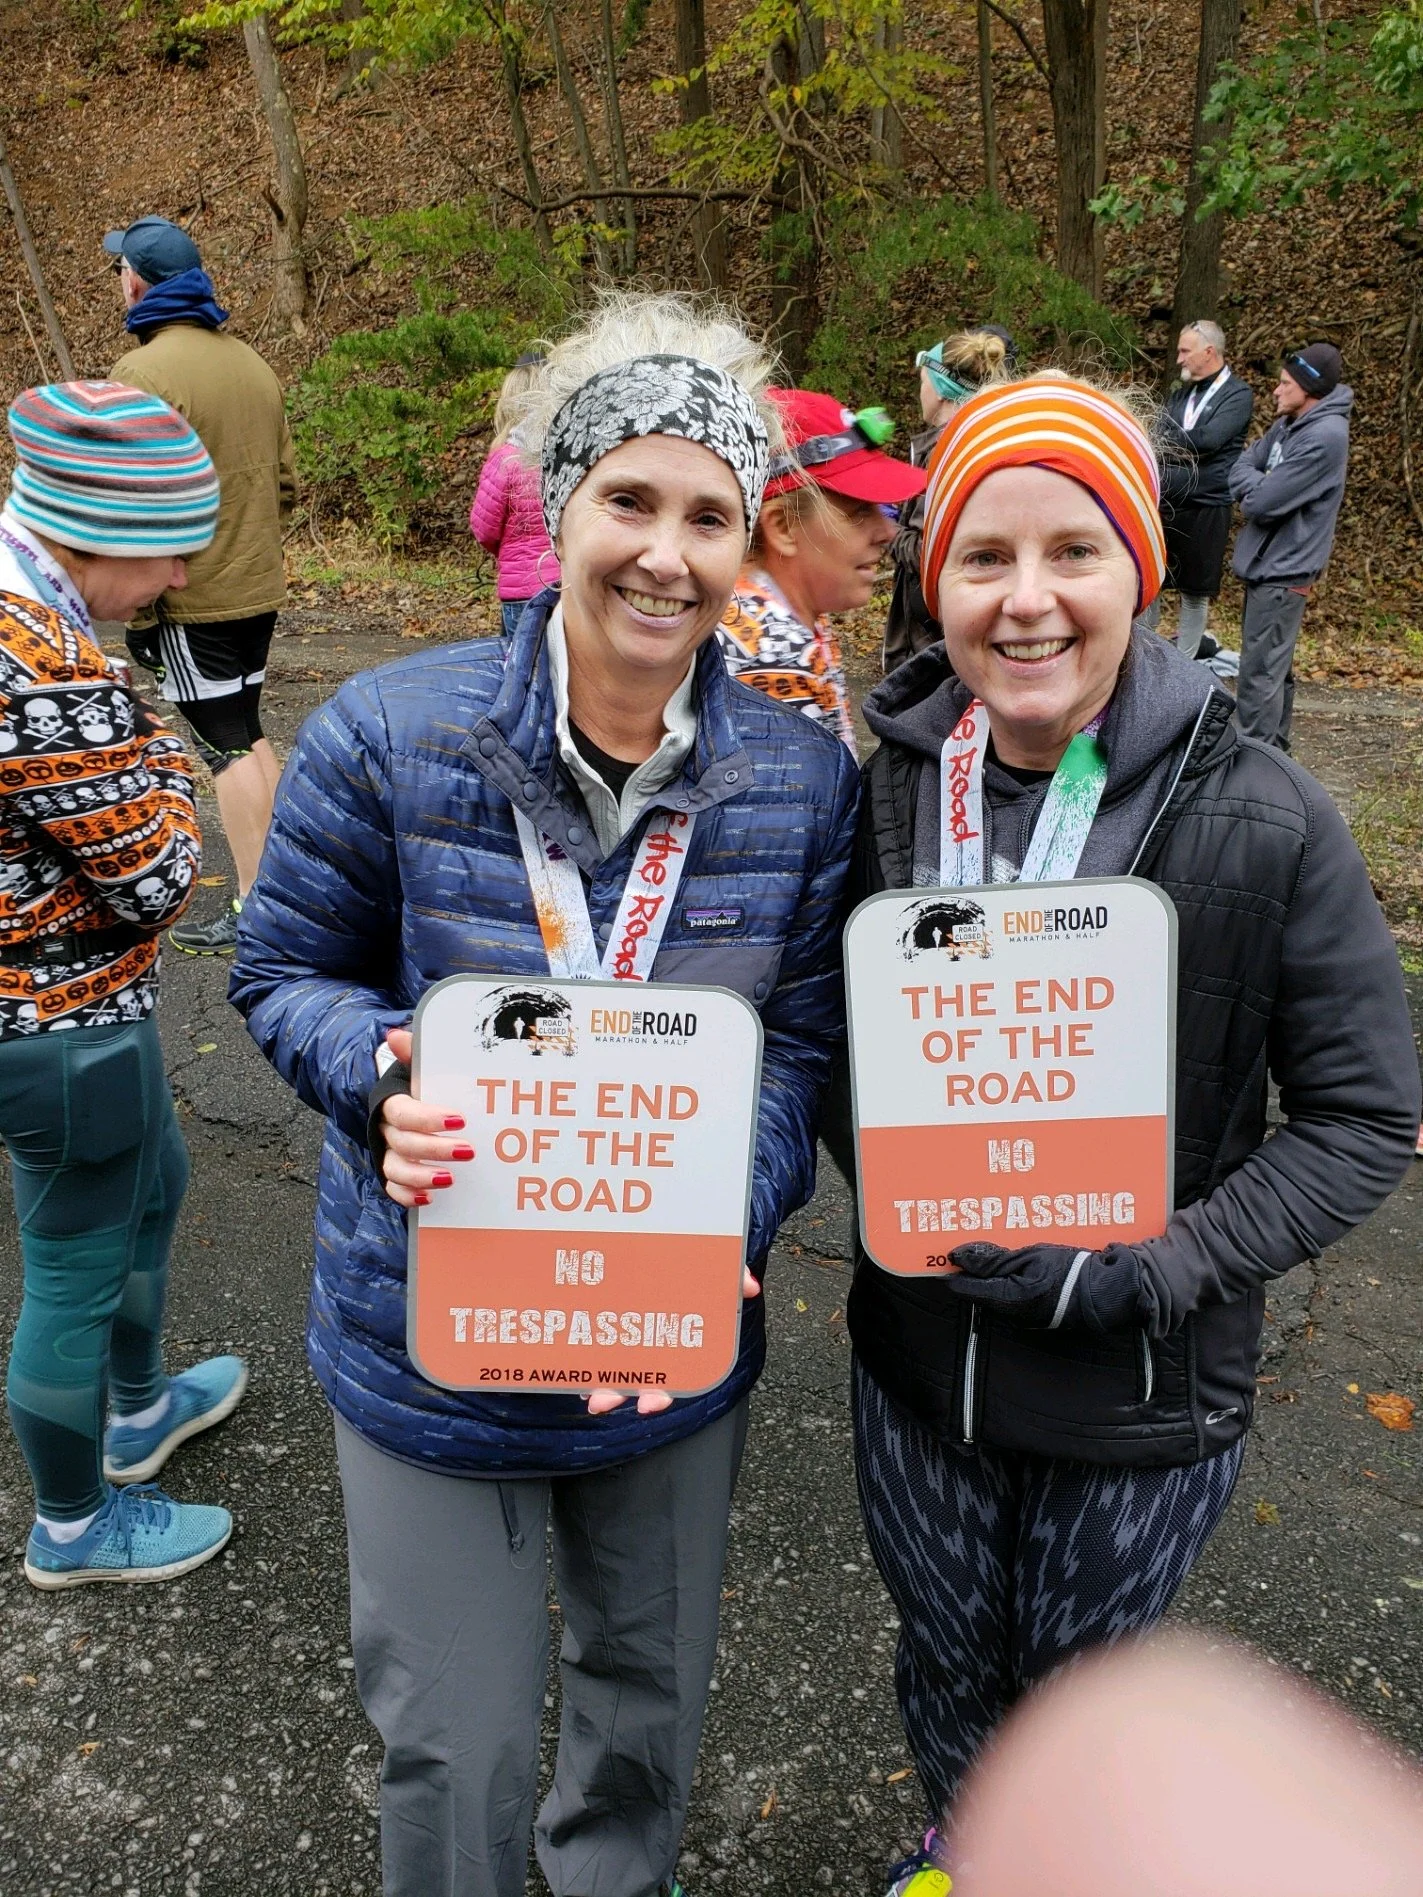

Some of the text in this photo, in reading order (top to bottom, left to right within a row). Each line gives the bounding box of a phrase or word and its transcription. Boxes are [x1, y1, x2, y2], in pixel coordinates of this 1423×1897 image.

[948, 747, 979, 843] Road
[641, 831, 684, 886] the
[613, 895, 665, 981] Road
[690, 918, 738, 928] patagonia
[955, 933, 982, 941] CLOSED
[958, 925, 978, 933] ROAD
[1004, 906, 1108, 935] END OF THE ROAD
[1009, 935, 1060, 943] MARATHON
[901, 976, 1115, 1020] THE END
[538, 1027, 567, 1036] CLOSED
[542, 1018, 563, 1027] ROAD
[590, 1009, 697, 1037] END OF THE ROAD
[595, 1036, 647, 1045] MARATHON
[921, 1023, 1095, 1064] OF THE
[477, 1078, 700, 1120] THE END
[946, 1069, 1077, 1107] ROAD
[494, 1127, 676, 1168] OF THE
[987, 1138, 1035, 1173] NO
[517, 1176, 653, 1213] ROAD
[893, 1191, 1136, 1233] TRESPASSING
[554, 1249, 605, 1286] NO
[926, 1255, 947, 1267] 20
[449, 1307, 704, 1349] TRESPASSING
[479, 1368, 667, 1385] 2018 AWARD WINNER
